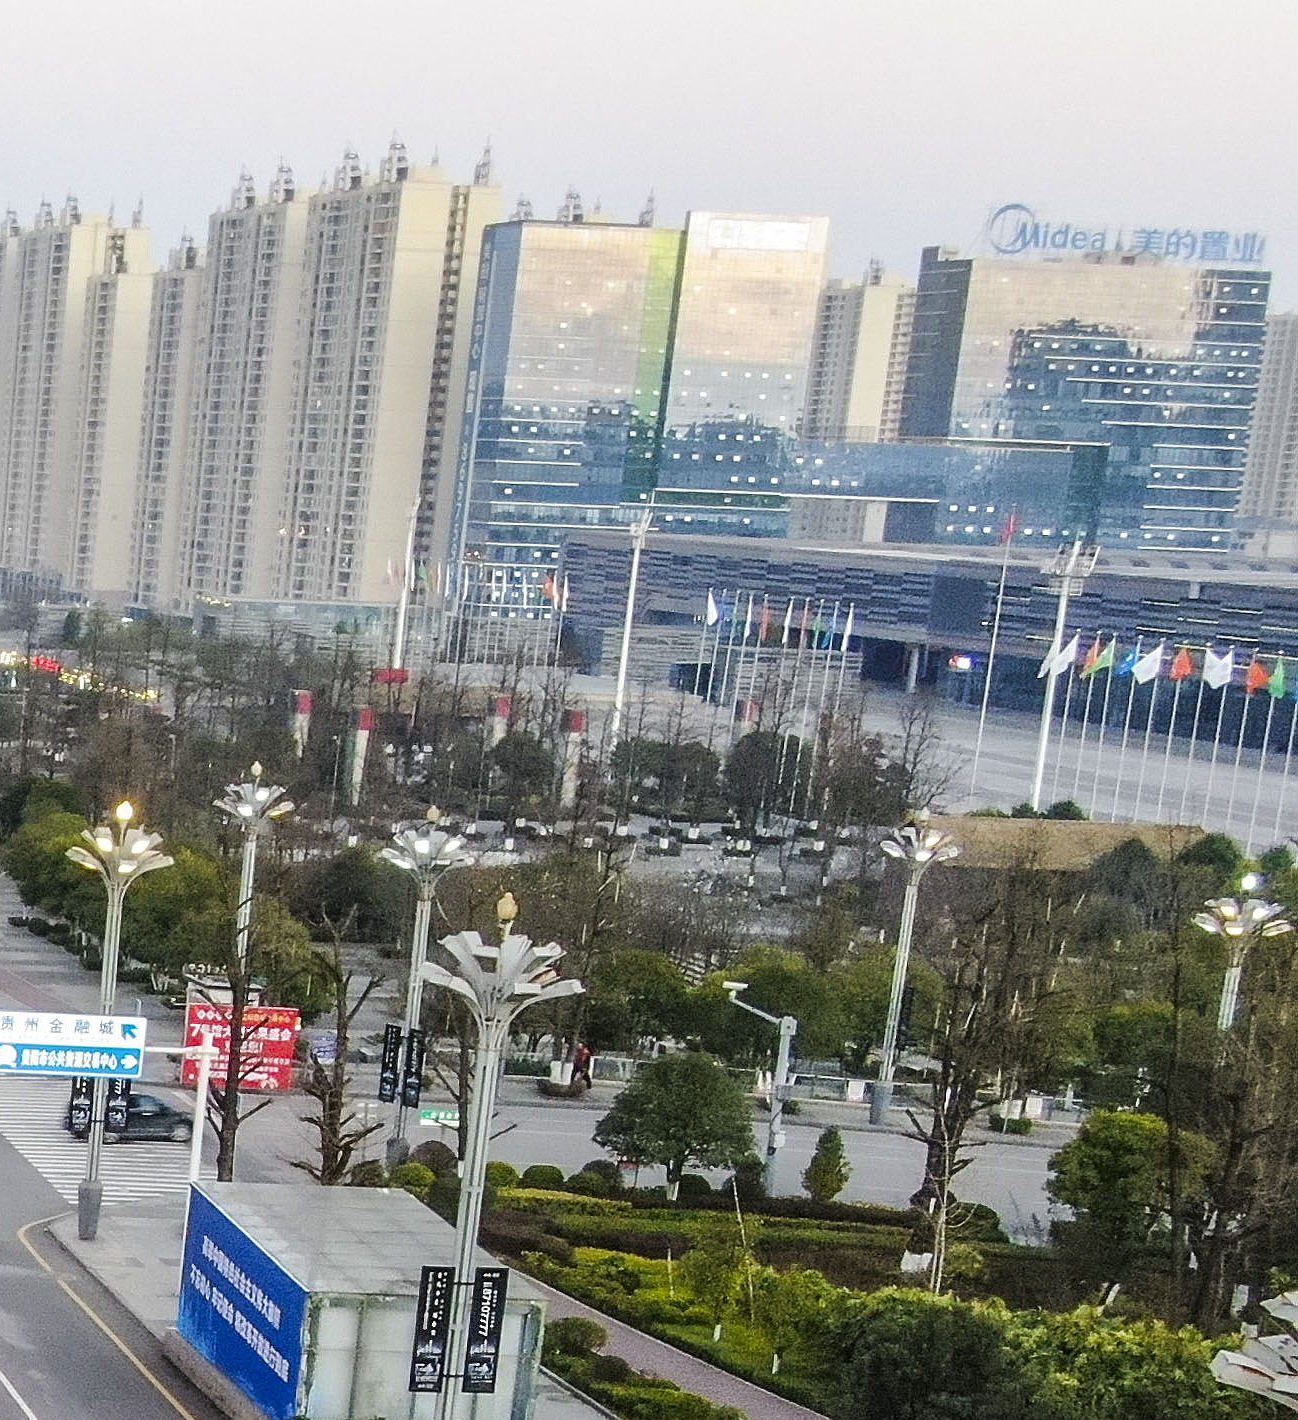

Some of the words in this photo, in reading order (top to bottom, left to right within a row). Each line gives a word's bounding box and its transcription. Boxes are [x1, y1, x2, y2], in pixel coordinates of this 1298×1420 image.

[1017, 221, 1106, 250] Midea
[1133, 228, 1266, 262] 美的置业
[1, 1015, 115, 1035] 贵州金融城
[21, 1049, 118, 1070] 贵阳市公共资源交易中心
[190, 1263, 211, 1301] 不忘初心
